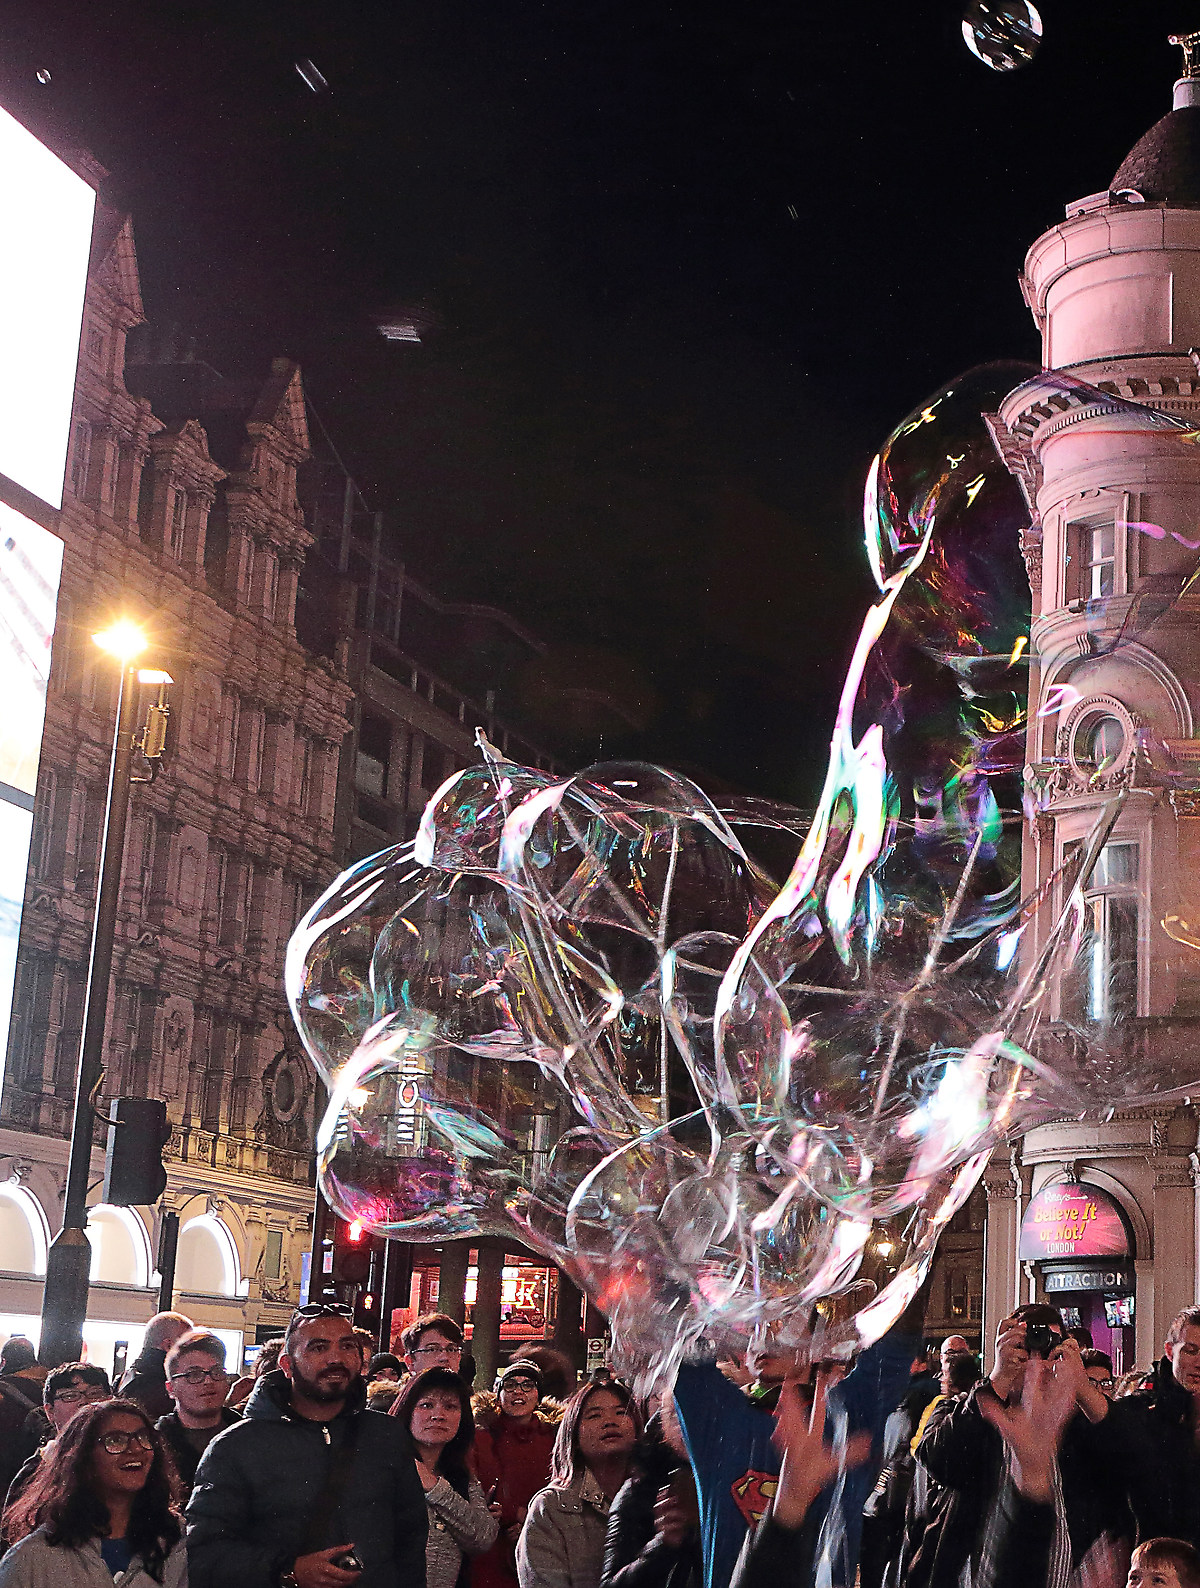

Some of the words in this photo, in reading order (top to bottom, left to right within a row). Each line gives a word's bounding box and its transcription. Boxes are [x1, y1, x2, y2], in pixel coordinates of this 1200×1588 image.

[1035, 1205, 1079, 1223] Believe
[1082, 1202, 1097, 1220] It
[1040, 1230, 1053, 1241] or
[1054, 1222, 1086, 1241] Not!
[1047, 1242, 1075, 1254] LONDON
[1047, 1272, 1129, 1289] ATTRACTION
